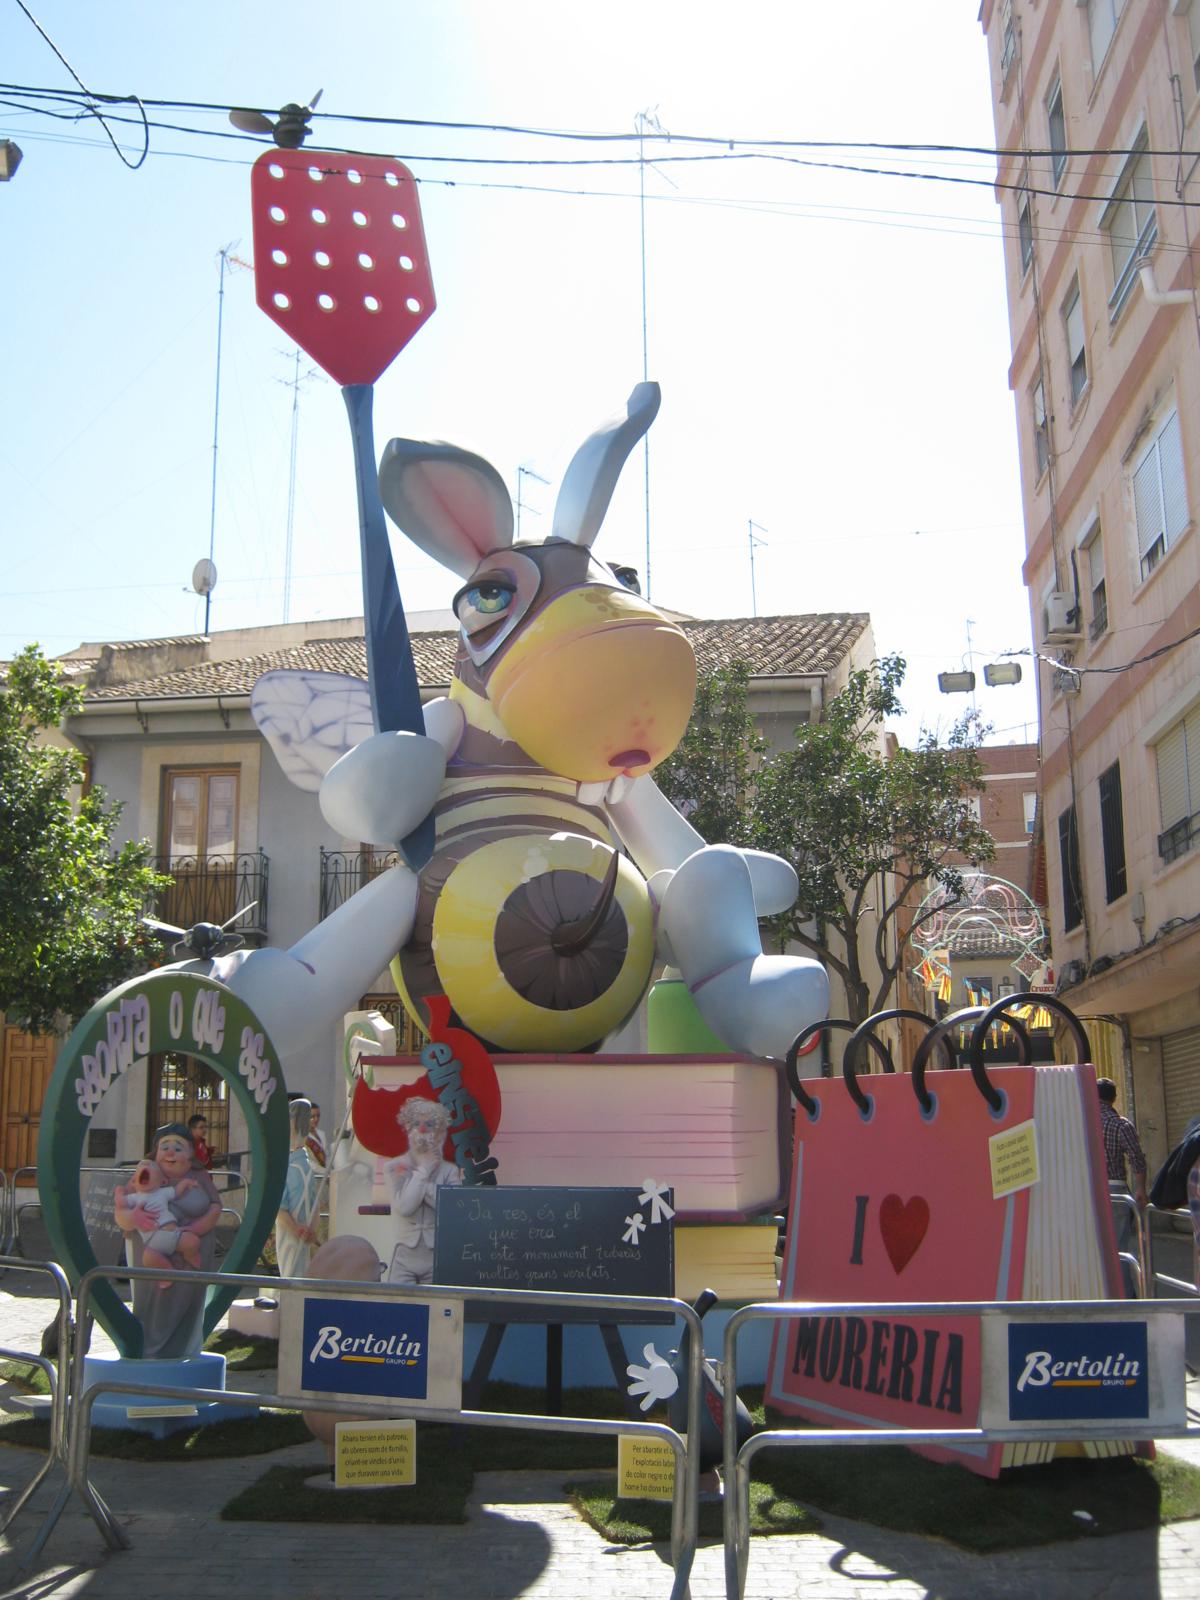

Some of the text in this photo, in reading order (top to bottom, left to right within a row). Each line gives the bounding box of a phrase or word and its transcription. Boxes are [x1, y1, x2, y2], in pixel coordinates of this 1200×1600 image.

[849, 1195, 870, 1266] I
[461, 1244, 482, 1262] En
[385, 1358, 407, 1366] GRUPO
[792, 1315, 963, 1414] MORERIA
[1102, 1378, 1125, 1387] GRUPO
